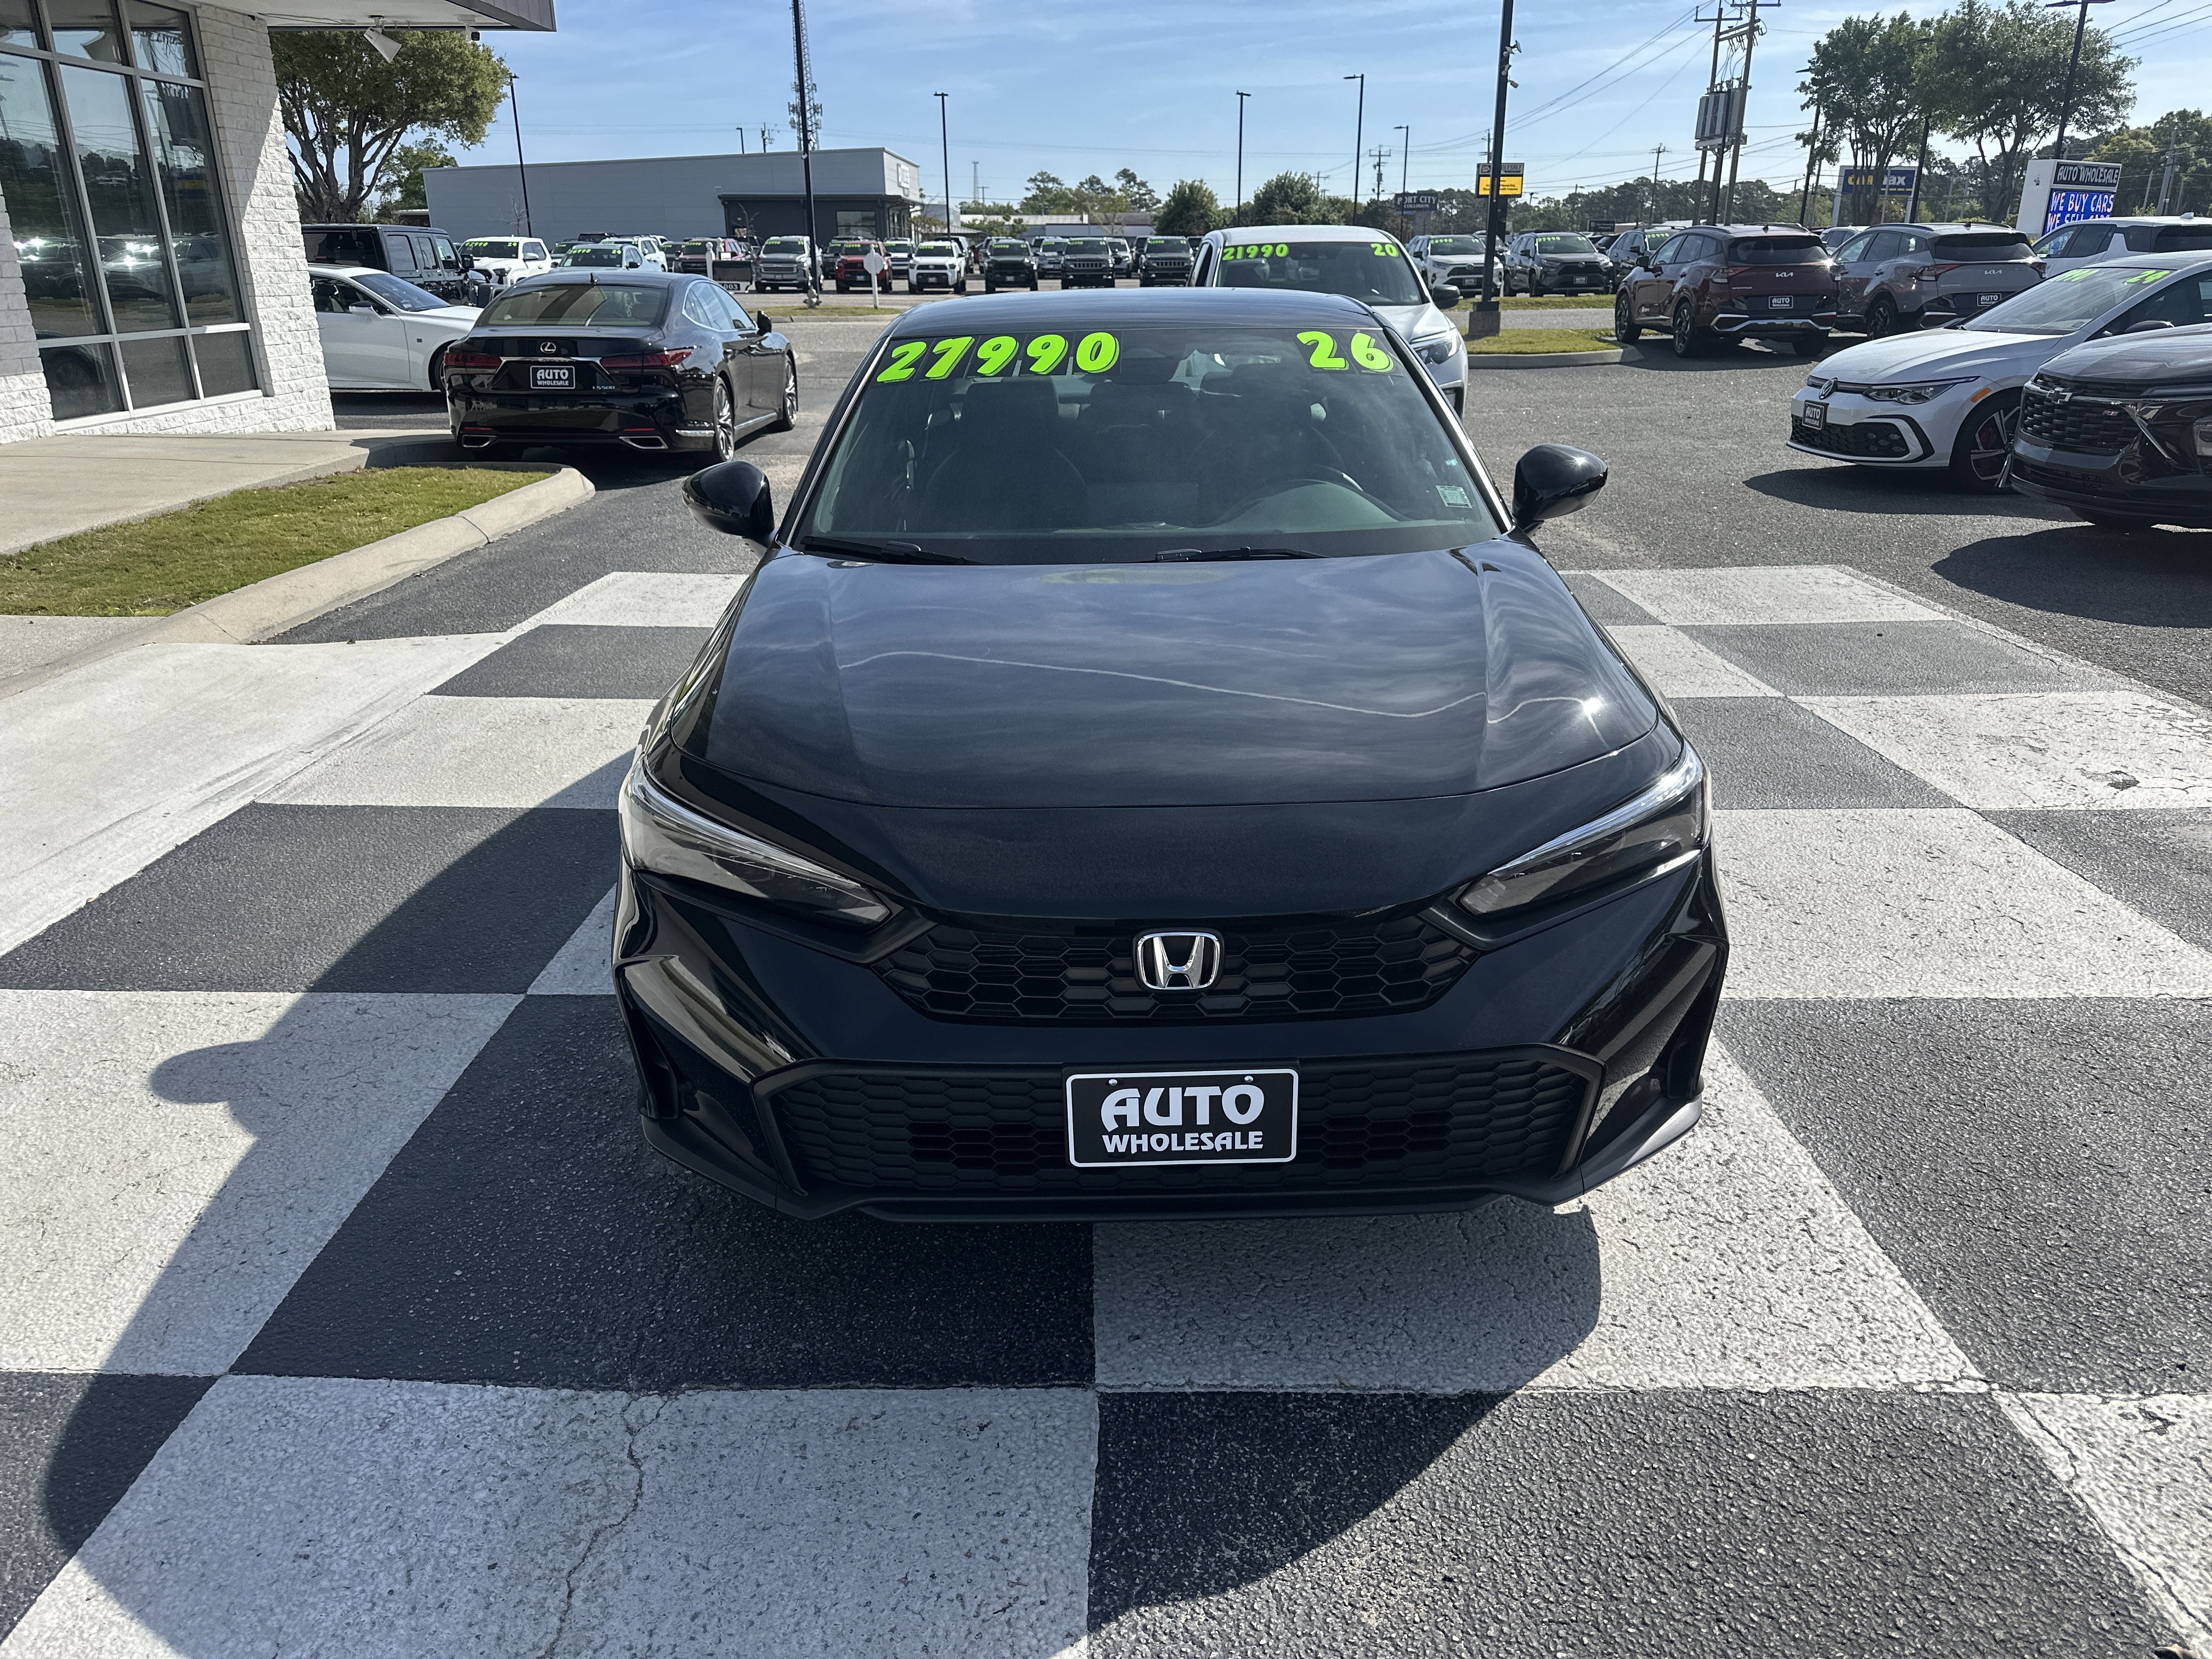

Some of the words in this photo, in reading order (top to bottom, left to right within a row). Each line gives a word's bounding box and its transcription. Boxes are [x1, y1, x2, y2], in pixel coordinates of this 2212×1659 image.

[2057, 166, 2078, 181] AUTO
[2079, 167, 2119, 183] WHOLESALE
[1419, 195, 1436, 204] CITY
[2051, 192, 2066, 211] WE
[2068, 193, 2089, 212] BUY
[2090, 194, 2114, 212] CARS
[2046, 213, 2061, 232] WE
[1222, 244, 1289, 261] 21990
[1370, 243, 1399, 257] 20
[877, 331, 1120, 383] 27990
[1296, 331, 1394, 373] 26
[537, 369, 568, 380] AUTO
[1805, 407, 1821, 419] AUTO
[1101, 1084, 1265, 1132] AUTO
[1102, 1131, 1263, 1154] WHOLESALE
